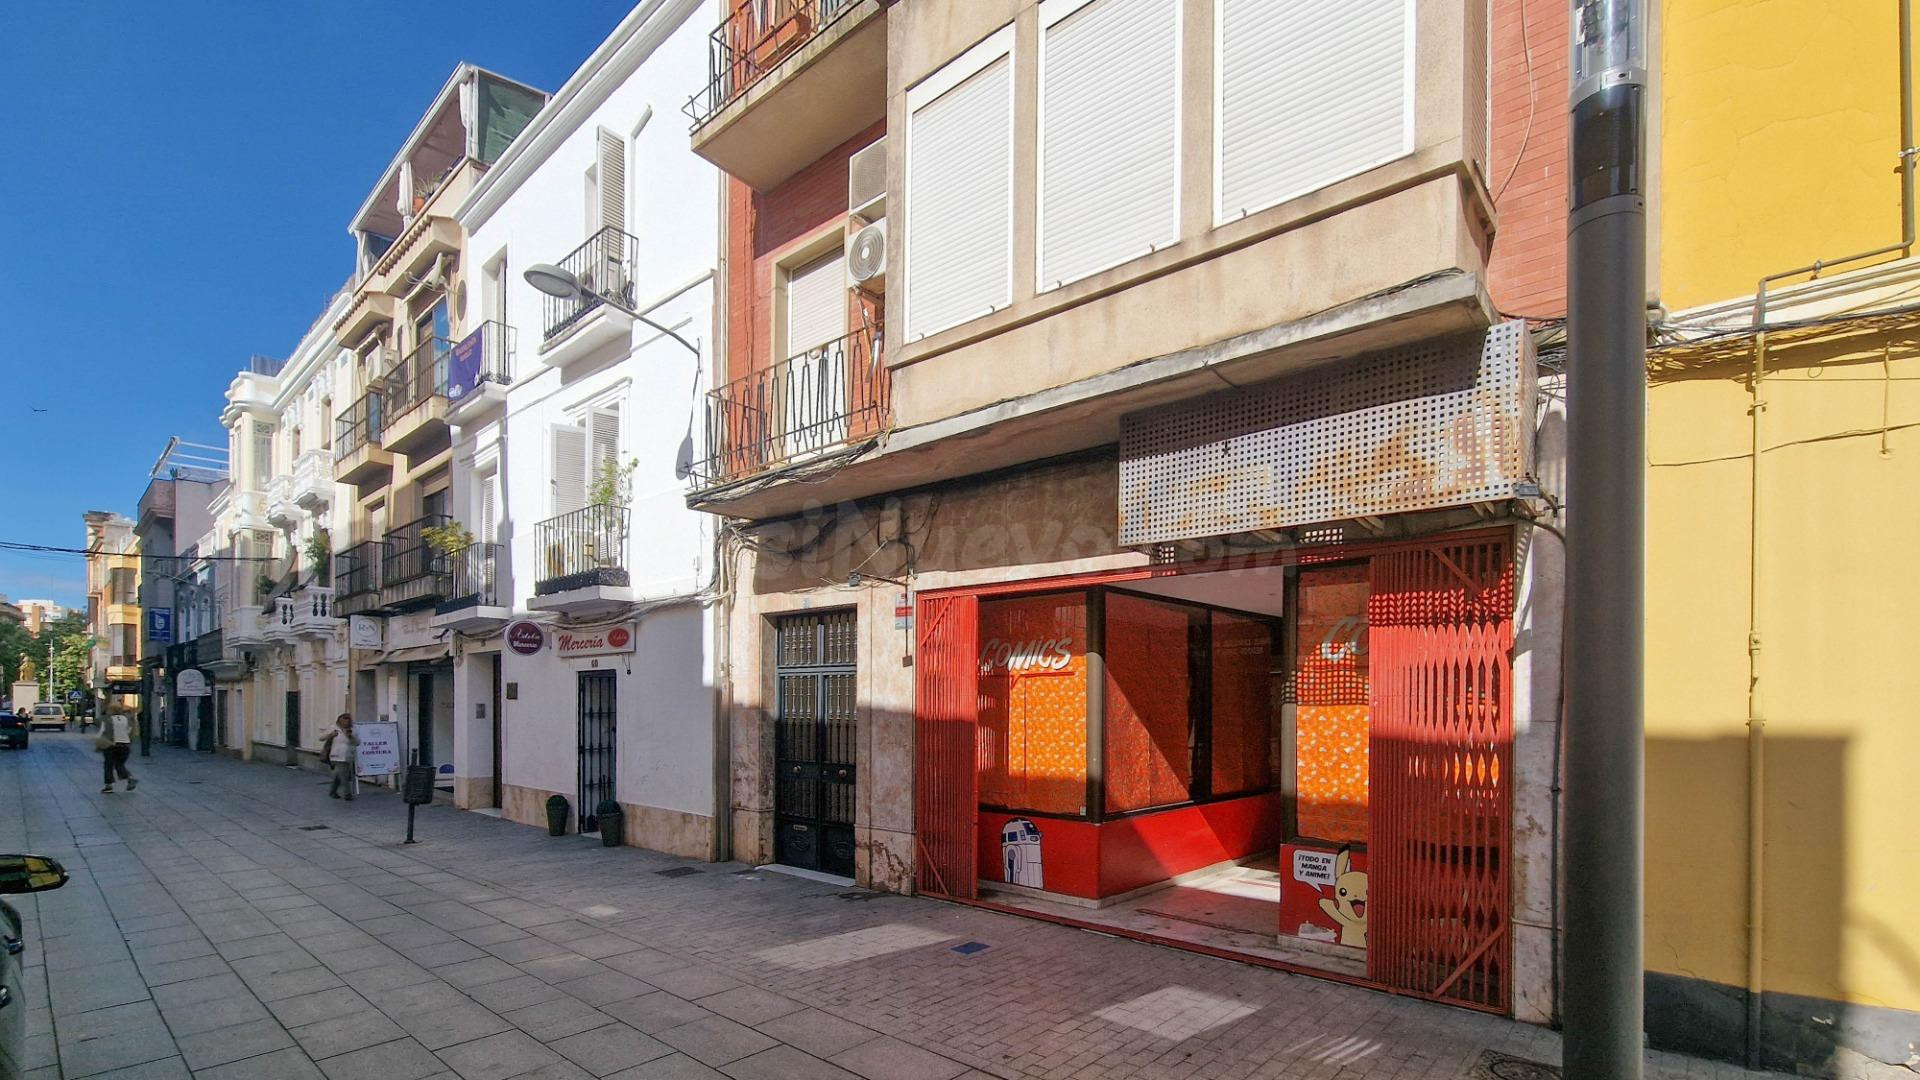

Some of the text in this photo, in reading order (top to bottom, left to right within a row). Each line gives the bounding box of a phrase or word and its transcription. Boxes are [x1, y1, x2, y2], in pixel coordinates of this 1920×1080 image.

[1298, 854, 1320, 863] ¡TODO
[1301, 862, 1327, 872] MANGA
[1305, 871, 1331, 880] ANIME!
